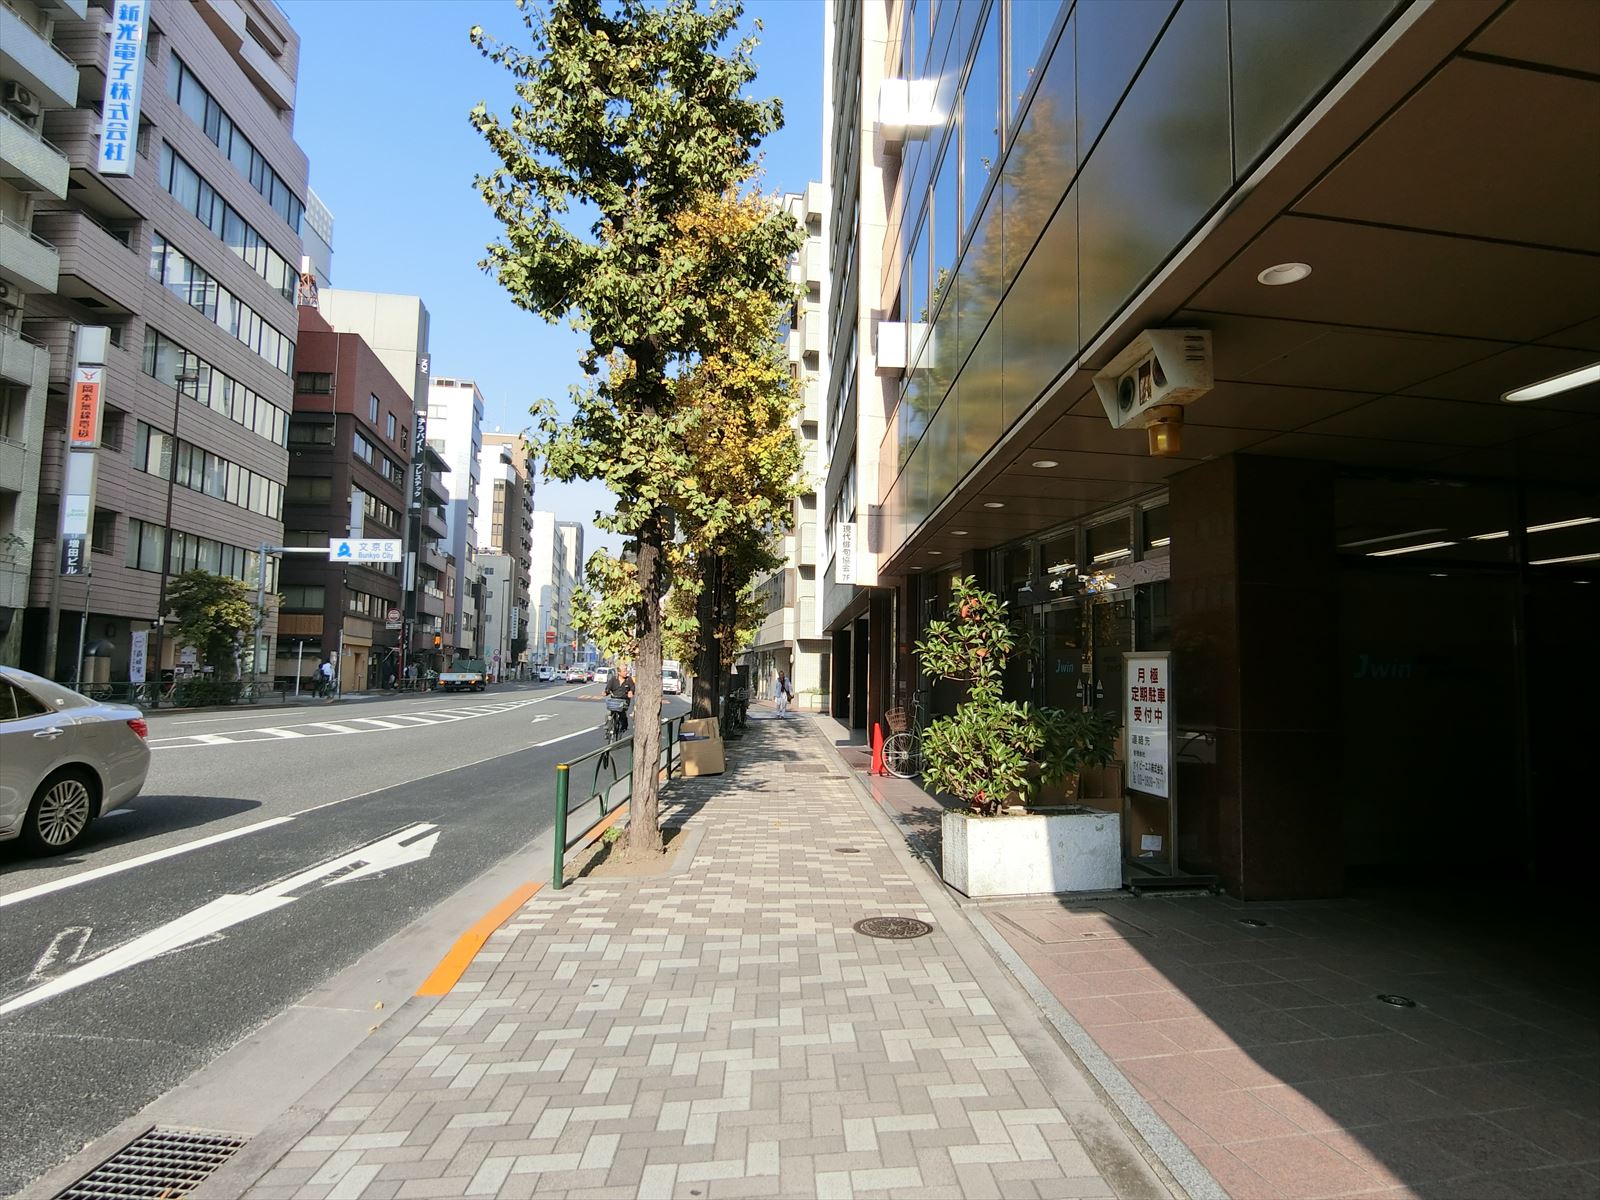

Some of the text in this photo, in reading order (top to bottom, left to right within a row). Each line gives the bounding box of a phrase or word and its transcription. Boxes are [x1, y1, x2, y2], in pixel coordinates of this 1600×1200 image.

[104, 4, 140, 161] 新光電子株式会社
[359, 543, 393, 552] 文京区
[382, 552, 393, 560] City
[66, 540, 80, 574] 増田ビル
[1138, 667, 1159, 684] 月極
[1131, 686, 1166, 704] 定期駐車
[1134, 706, 1163, 724] 受付中
